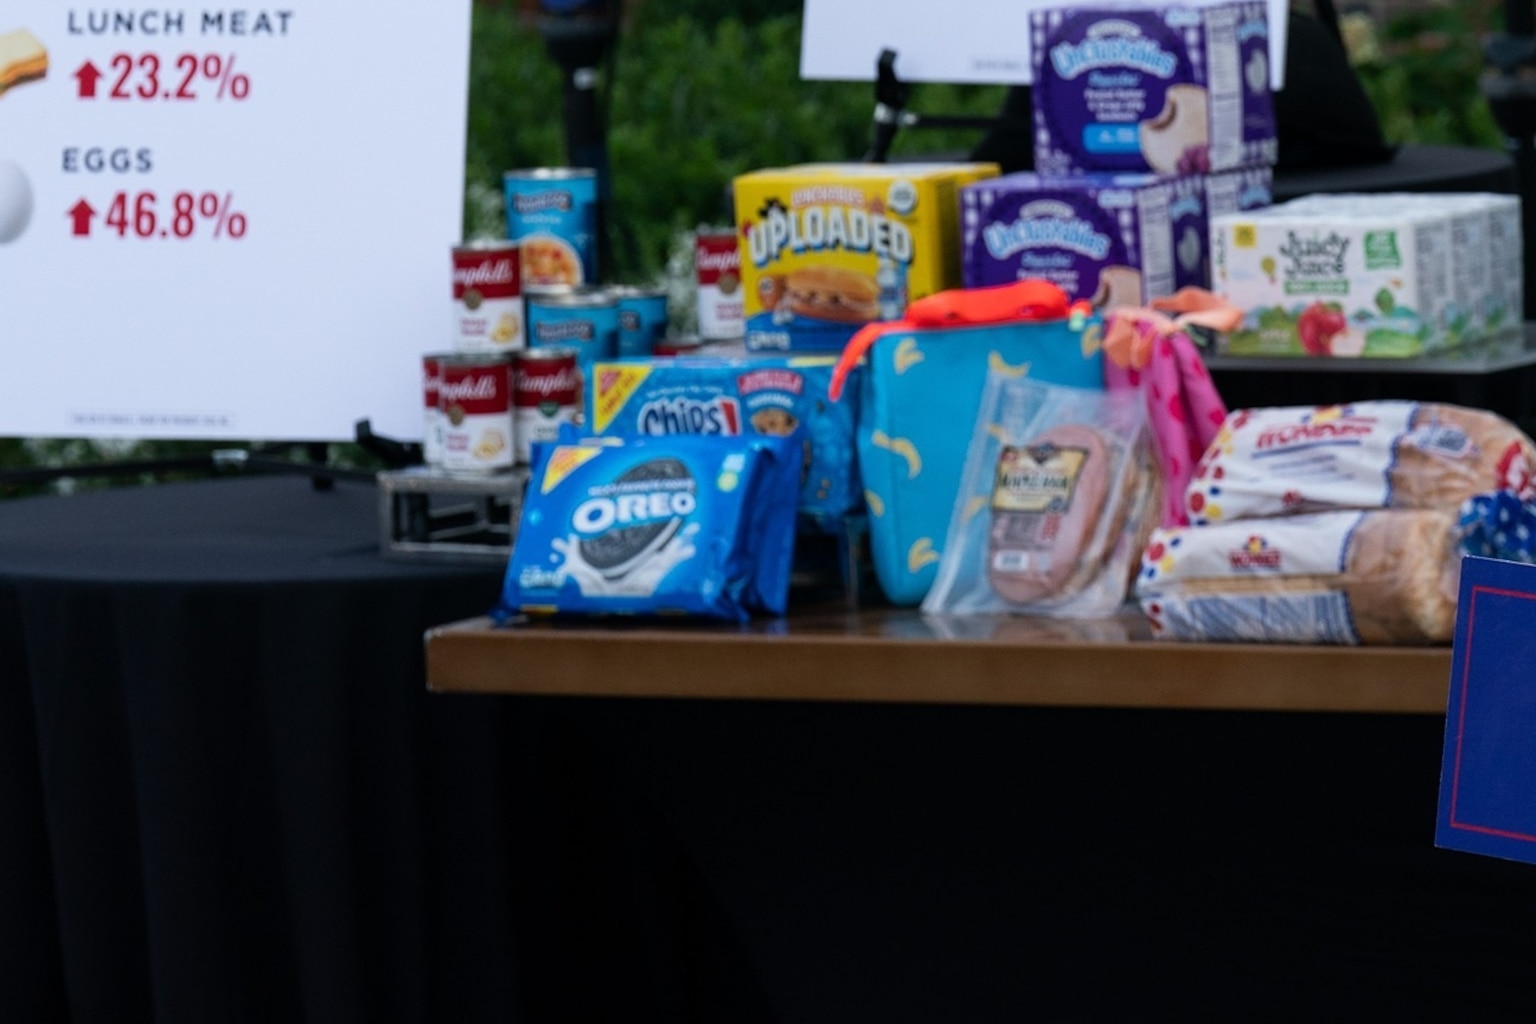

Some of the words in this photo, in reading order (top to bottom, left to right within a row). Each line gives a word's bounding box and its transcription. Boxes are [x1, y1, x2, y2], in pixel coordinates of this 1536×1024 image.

[68, 10, 184, 35] LUNCH
[201, 11, 292, 35] MEAT
[110, 53, 249, 100] 23.2%
[62, 148, 152, 173] EGGS
[105, 192, 246, 238] 46.8%
[751, 206, 912, 265] UPLOADED
[572, 491, 697, 534] OREO
